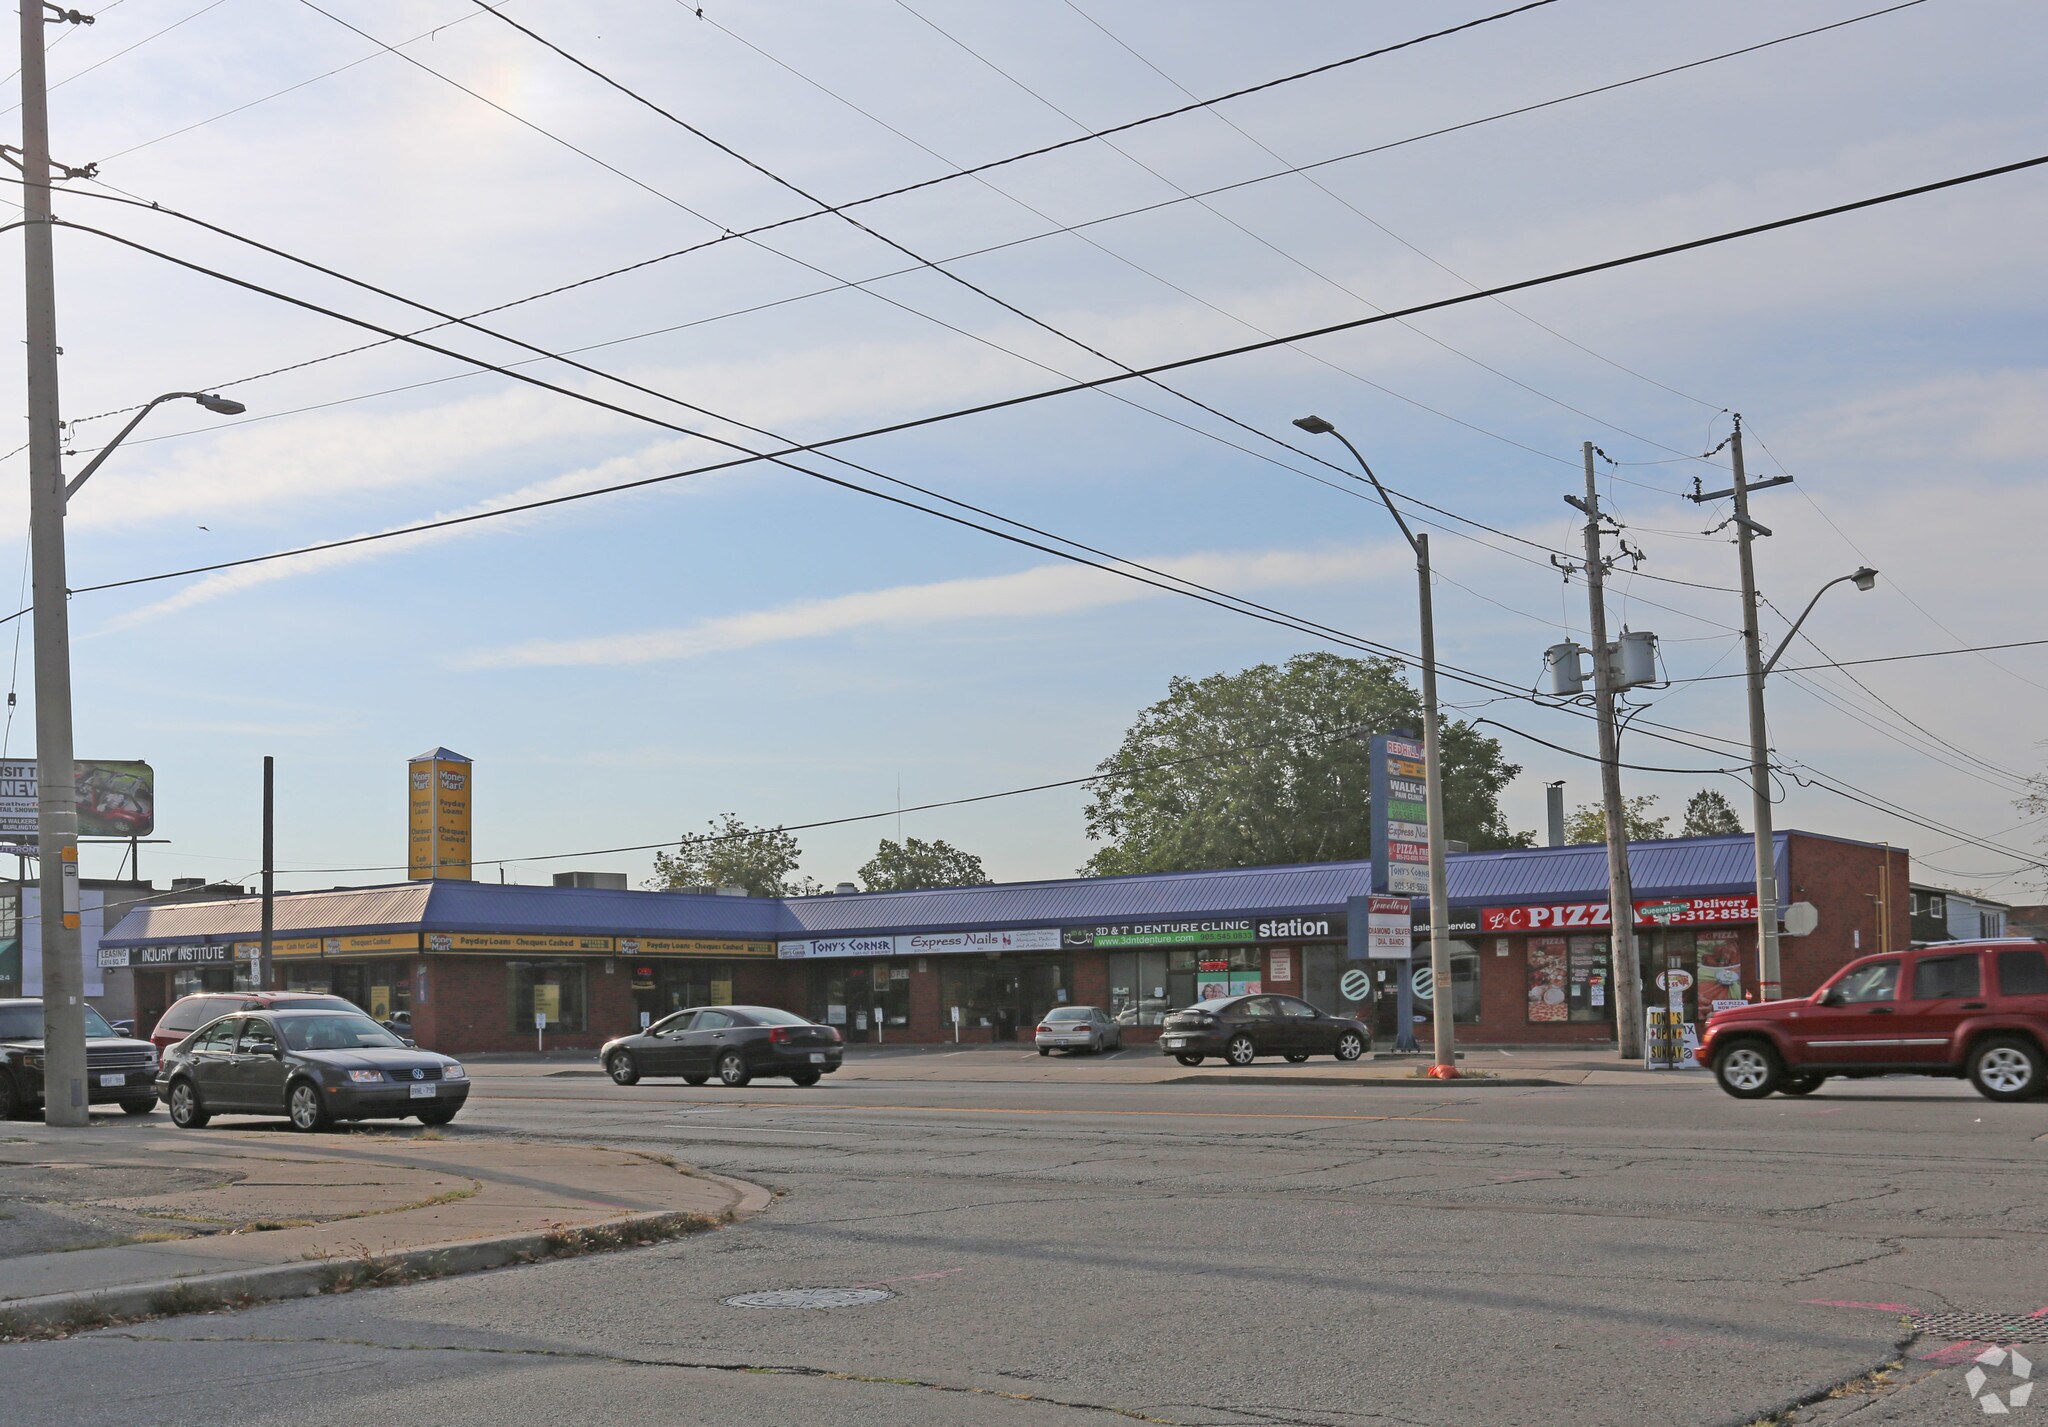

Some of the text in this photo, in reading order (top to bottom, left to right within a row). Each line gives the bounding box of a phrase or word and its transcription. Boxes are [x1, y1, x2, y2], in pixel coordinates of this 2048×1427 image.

[412, 773, 430, 782] Money
[440, 771, 466, 782] Money
[414, 781, 428, 790] Mart
[442, 780, 462, 790] Mart
[1390, 780, 1427, 794] WALK-IN
[440, 799, 465, 808] Payday
[439, 827, 468, 836] Cheques
[1388, 824, 1414, 838] Express
[441, 835, 466, 843] Cashed
[1396, 843, 1418, 856] PIZZA
[1369, 899, 1408, 913] Jewellery
[1694, 899, 1748, 909] Delivery
[1641, 906, 1680, 915] Queenston
[1653, 908, 1759, 922] 95-312-8585
[1096, 921, 1249, 936] 3D & T DENTURE CLINIC
[1259, 918, 1328, 937] station
[1447, 922, 1476, 930] service
[430, 936, 453, 944] Money
[461, 937, 488, 945] Payday
[516, 938, 546, 946] Cheques
[911, 933, 998, 949] Express Nails
[431, 942, 450, 951] Mart
[101, 949, 126, 958] LEASING
[142, 947, 224, 962] INJURY INSTITUTE
[1651, 1012, 1681, 1024] TON'S
[1657, 1028, 1676, 1039] OPN
[1652, 1046, 1682, 1058] SUNAY
